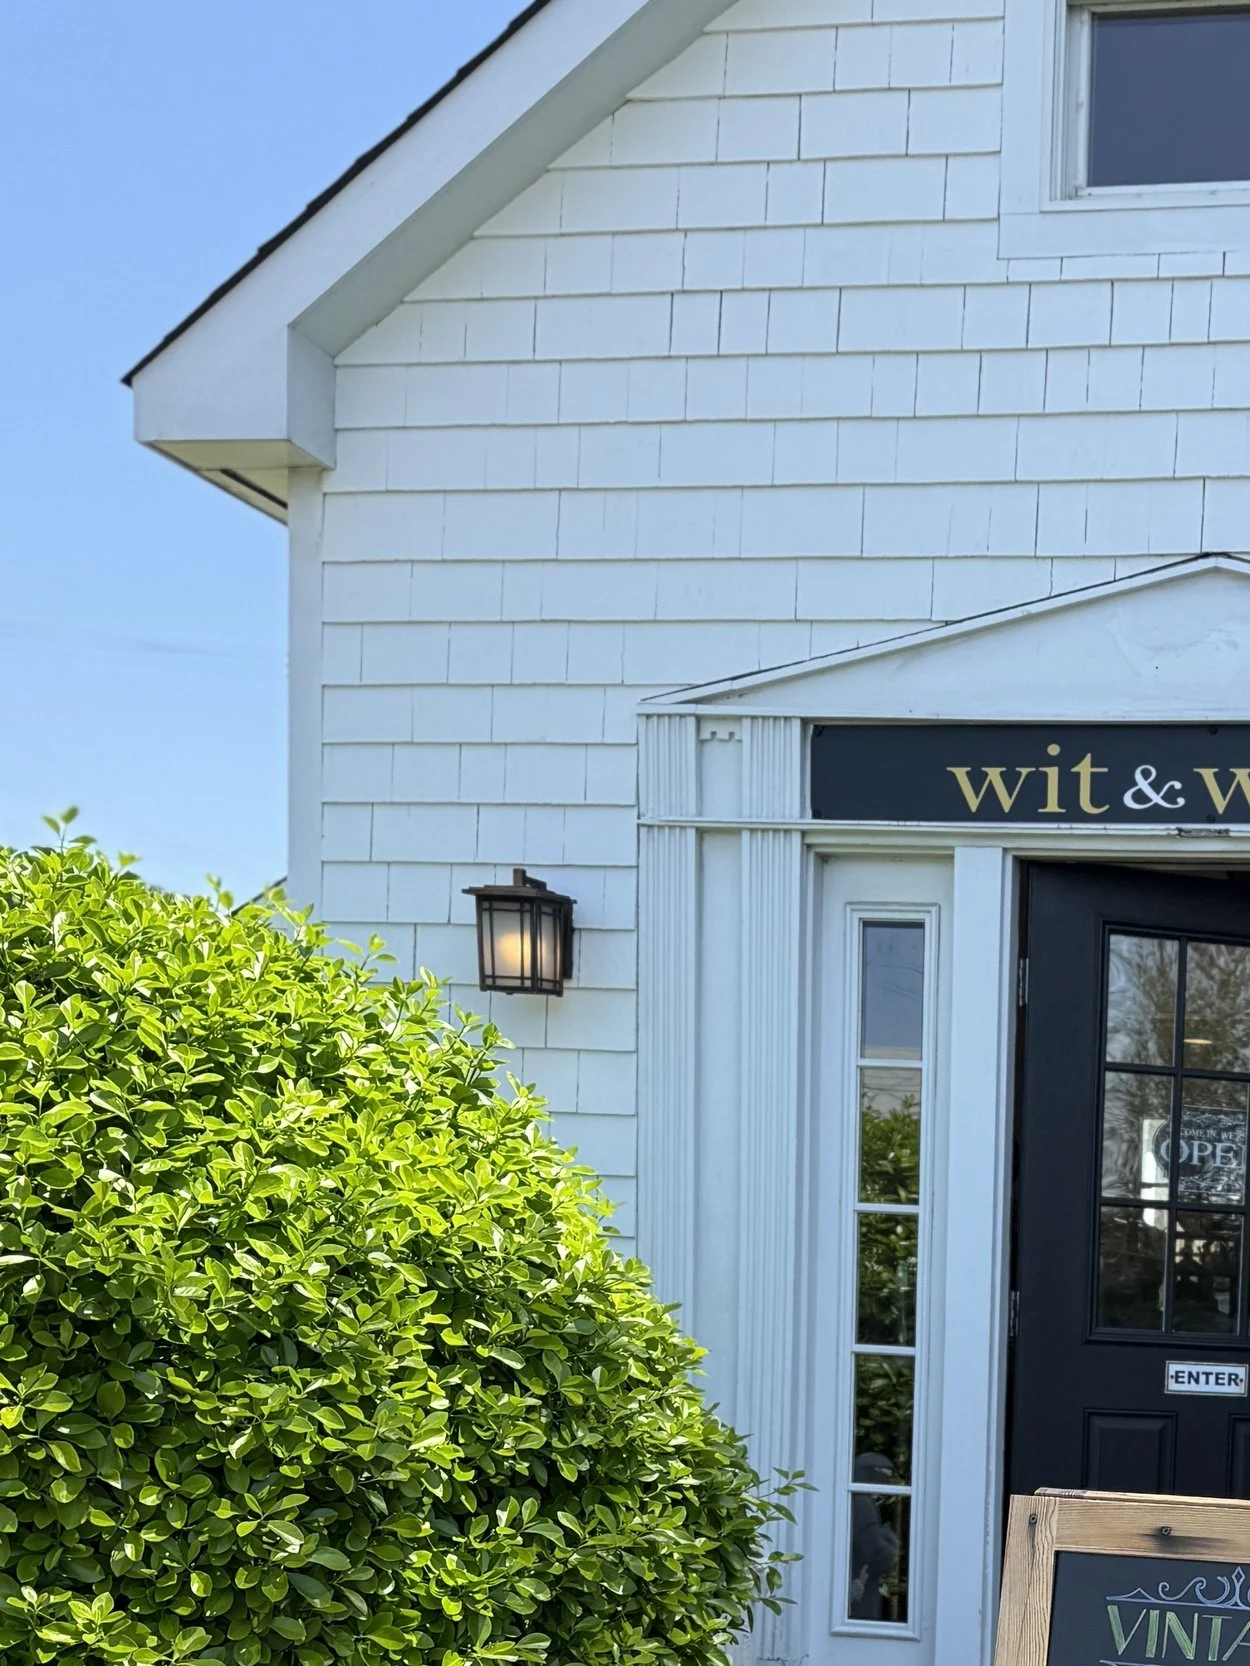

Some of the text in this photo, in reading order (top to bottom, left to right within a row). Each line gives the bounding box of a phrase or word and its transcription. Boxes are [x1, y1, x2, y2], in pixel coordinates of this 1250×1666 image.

[947, 743, 1110, 815] wit
[1122, 764, 1186, 811] &
[1174, 1370, 1240, 1386] ENTER
